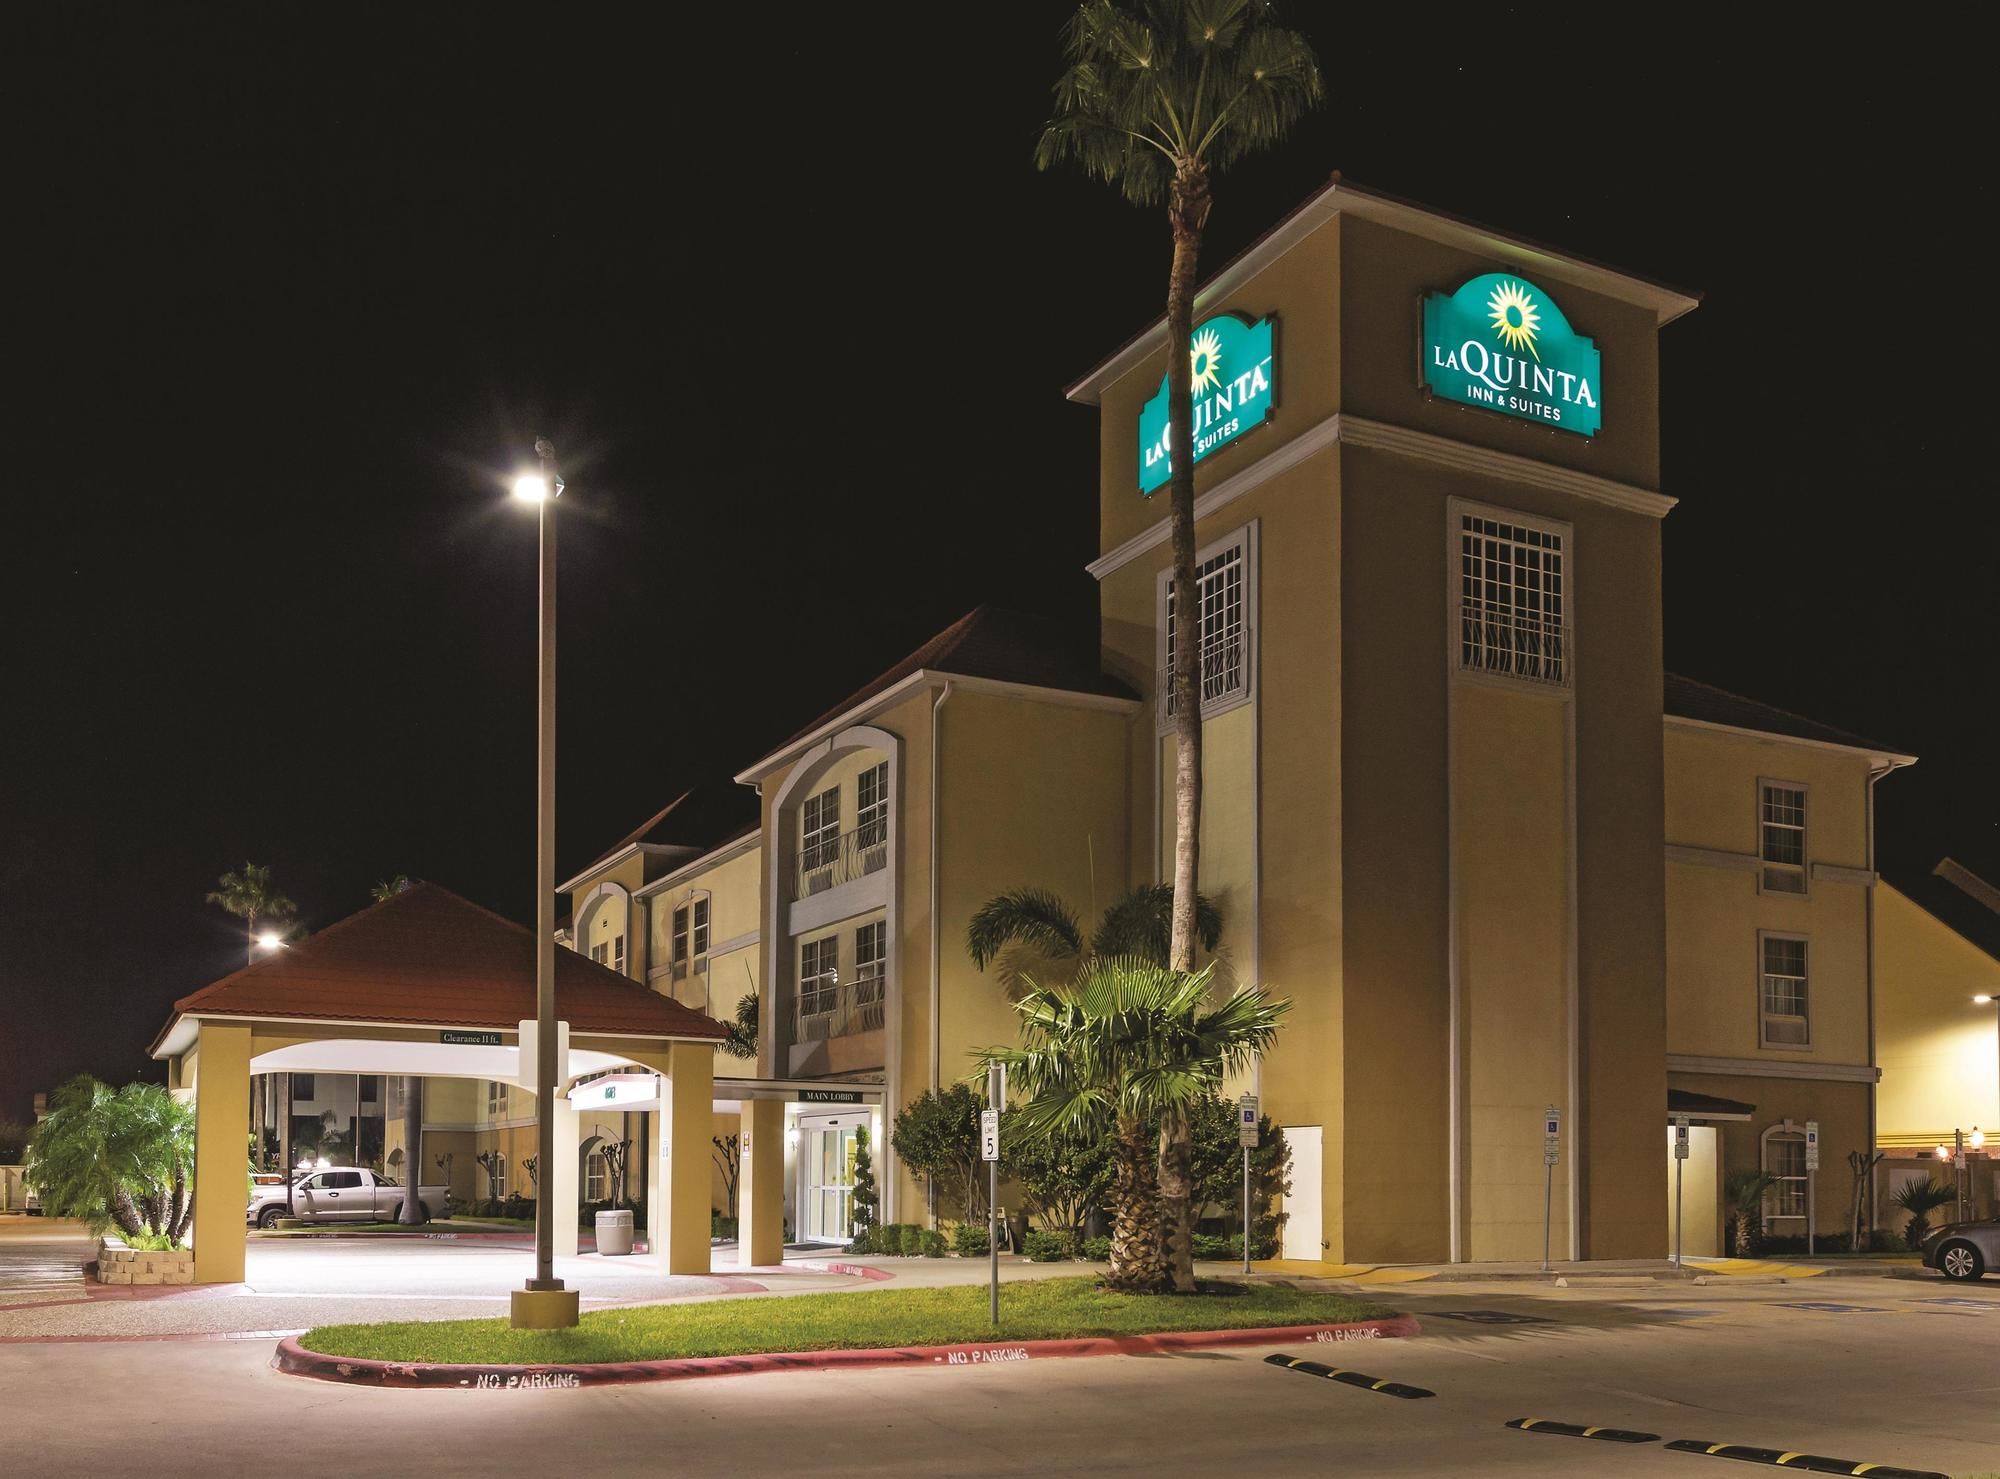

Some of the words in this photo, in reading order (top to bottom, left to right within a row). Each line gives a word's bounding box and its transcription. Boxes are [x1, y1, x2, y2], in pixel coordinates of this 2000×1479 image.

[1434, 345, 1460, 371] LA
[1460, 340, 1597, 408] QUINTA
[1467, 384, 1493, 403] INN
[1497, 394, 1506, 407] &
[1509, 396, 1562, 421] SUITES
[1145, 442, 1164, 467] LA
[1162, 364, 1268, 452] INTA
[1197, 418, 1239, 453] SUITES
[443, 1033, 480, 1043] Clearance
[807, 1092, 829, 1100] MAIN
[830, 1092, 855, 1101] LOBBY
[987, 1137, 994, 1155] 5
[1316, 1330, 1333, 1343] NO
[1335, 1327, 1381, 1341] PARKING
[947, 1351, 968, 1364] NO
[971, 1347, 1029, 1363] PARKING
[476, 1374, 501, 1389] NO
[505, 1373, 580, 1389] PARKING
